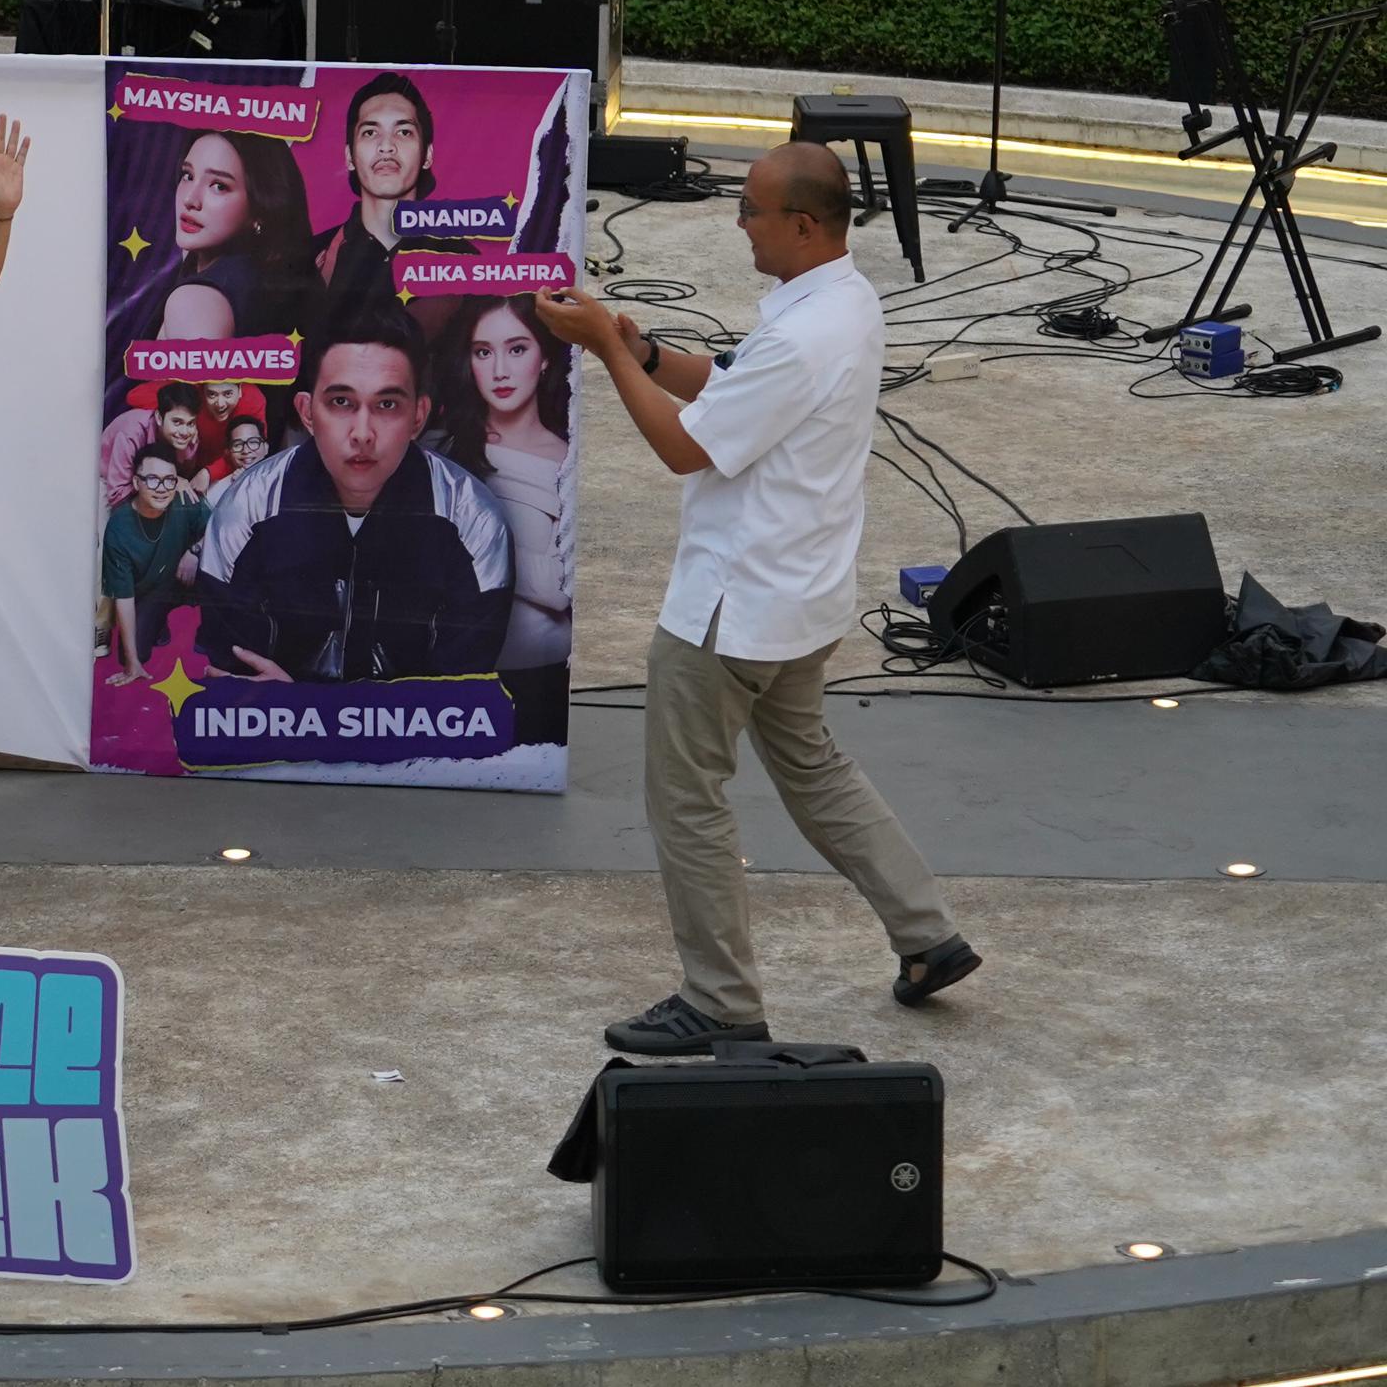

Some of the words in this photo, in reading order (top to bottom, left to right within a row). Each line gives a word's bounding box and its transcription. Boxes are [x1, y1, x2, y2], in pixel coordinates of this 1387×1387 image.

[123, 87, 231, 115] MAYSHA
[237, 98, 306, 122] JUAN
[401, 209, 505, 228] DNANDA
[403, 266, 467, 283] ALIKA
[472, 264, 567, 282] SHAFIRA
[134, 349, 295, 370] TONEWAVES
[194, 708, 327, 737] INDRA
[337, 708, 496, 738] SINAGA
